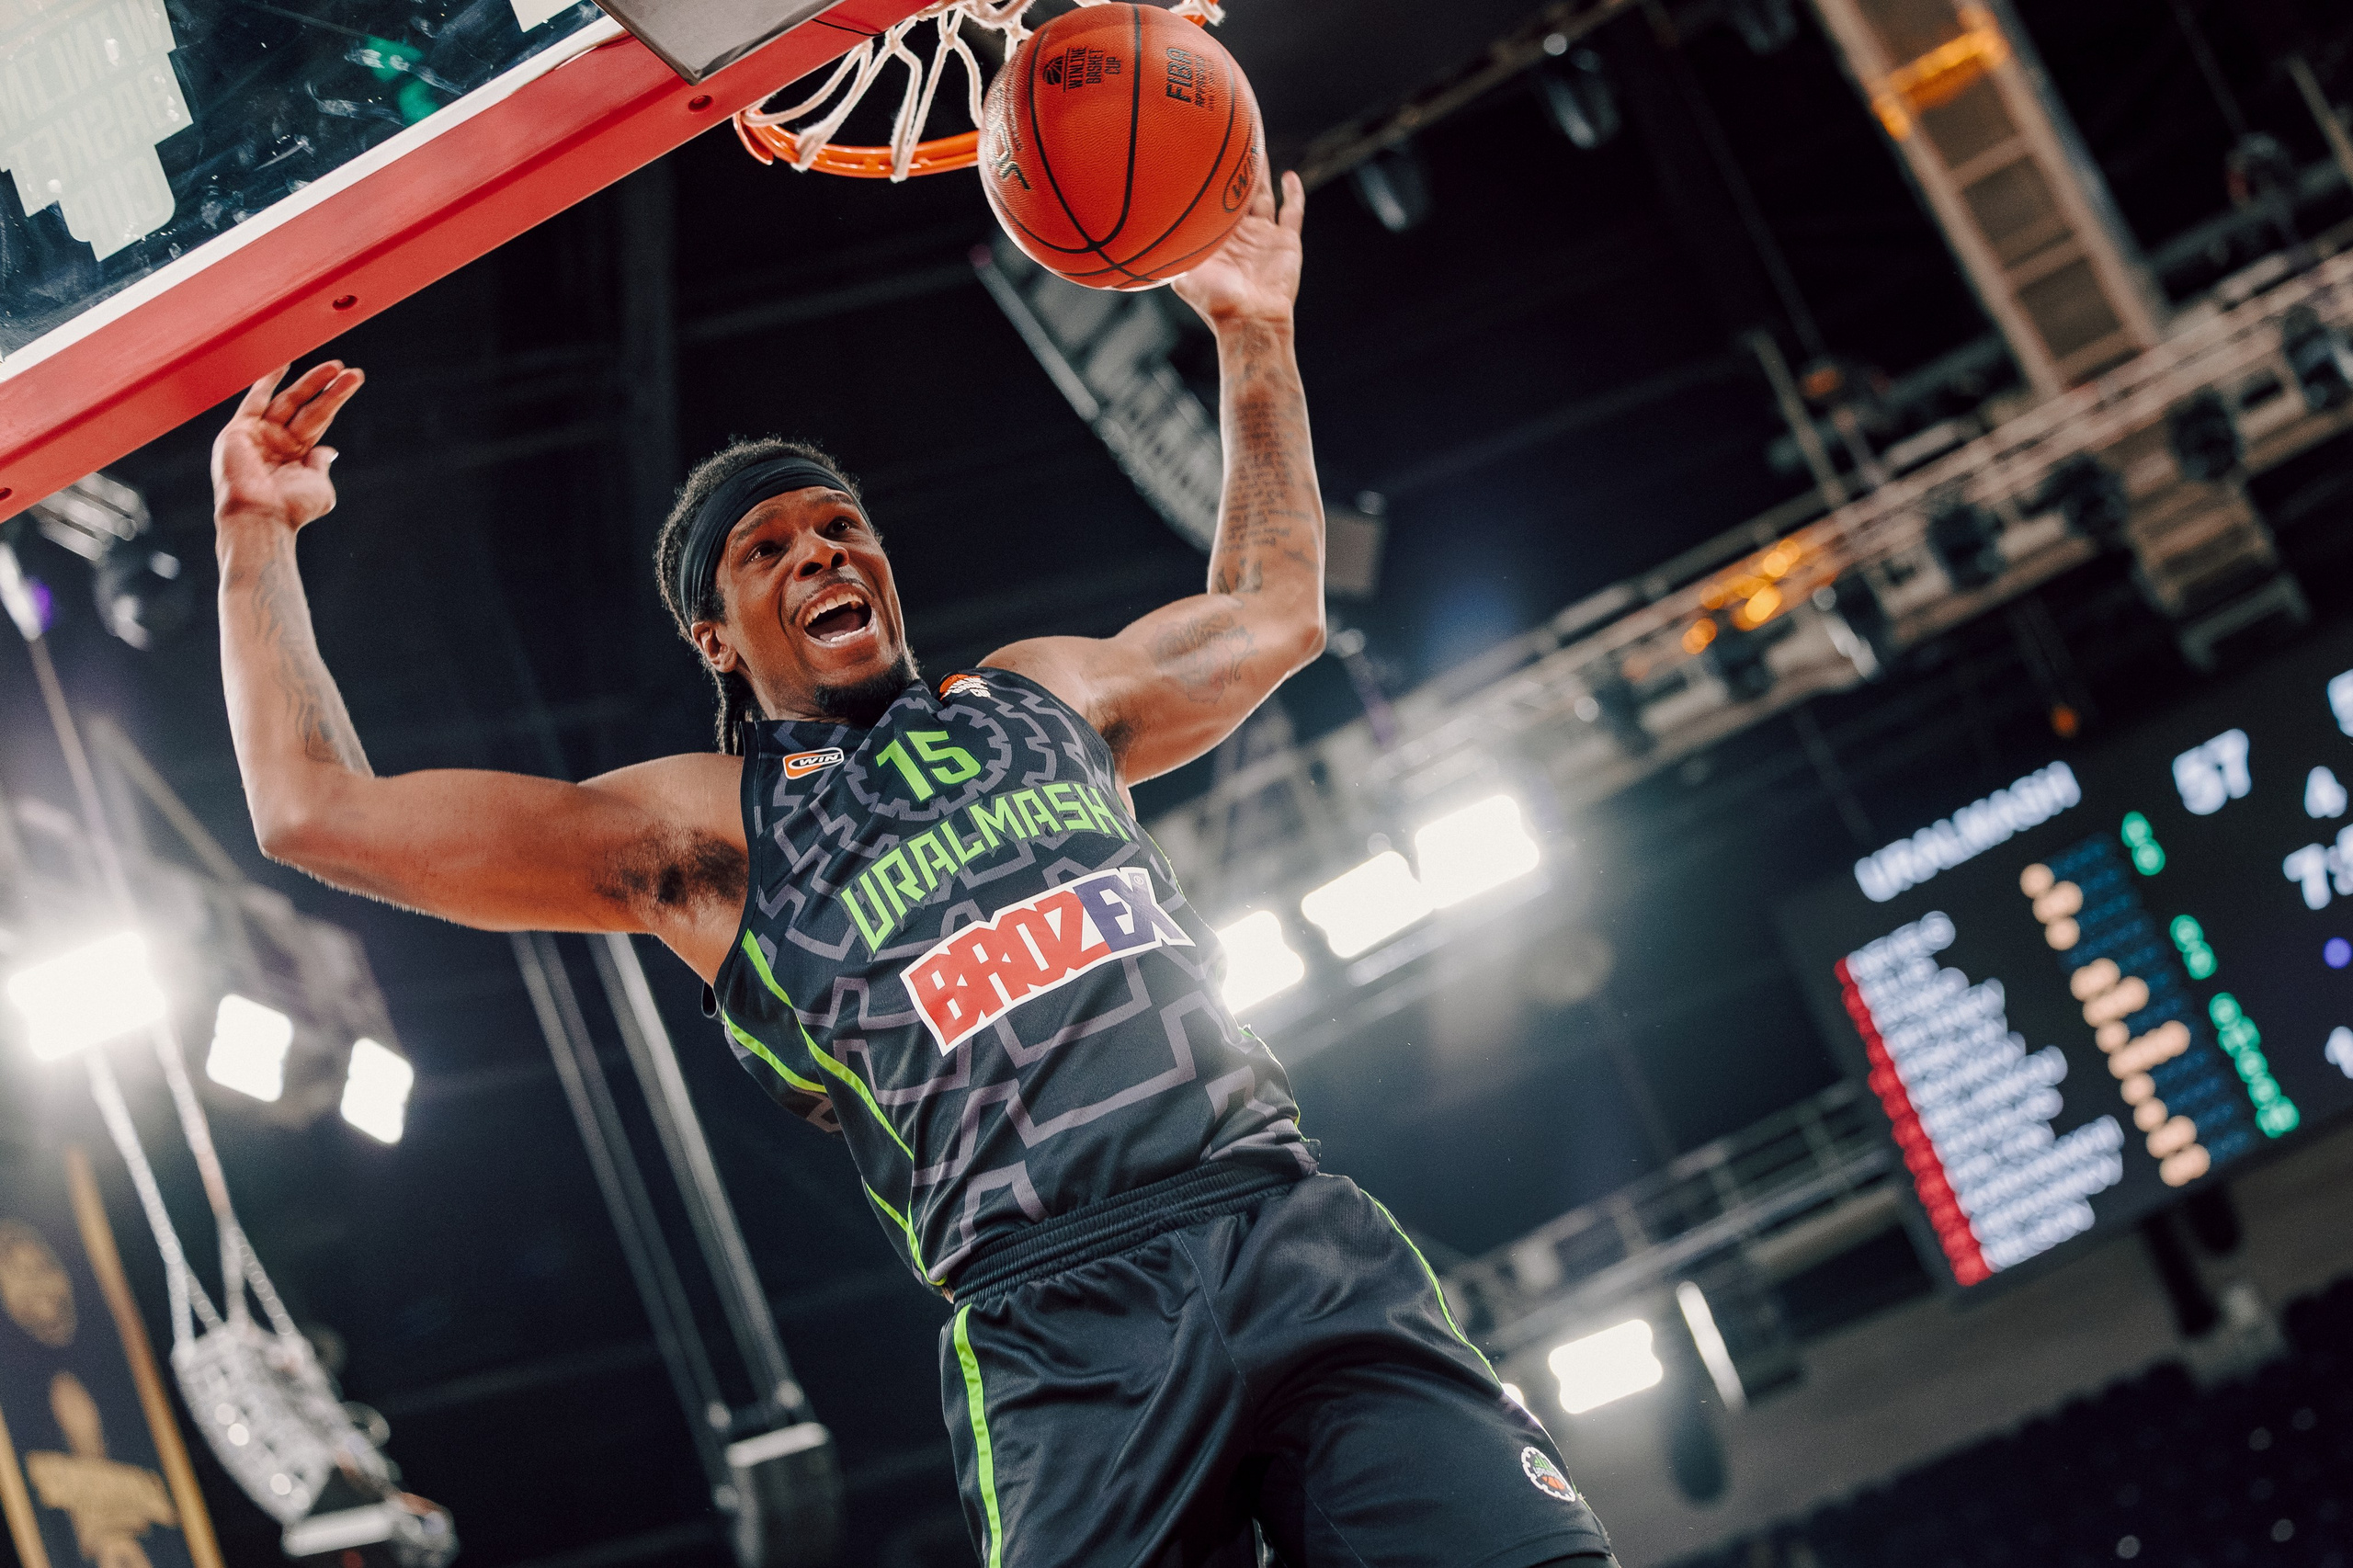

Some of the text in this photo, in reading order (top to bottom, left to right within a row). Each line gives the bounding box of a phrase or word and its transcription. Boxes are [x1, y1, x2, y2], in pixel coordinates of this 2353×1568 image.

[1068, 47, 1086, 89] WINLINE
[1086, 50, 1104, 84] BASKET
[1105, 56, 1121, 74] CUP
[1166, 48, 1193, 102] FIBA
[800, 755, 838, 767] WIN
[876, 730, 982, 801] 15
[841, 782, 1130, 953] URALMASH
[908, 869, 1194, 1046] BROZEX
